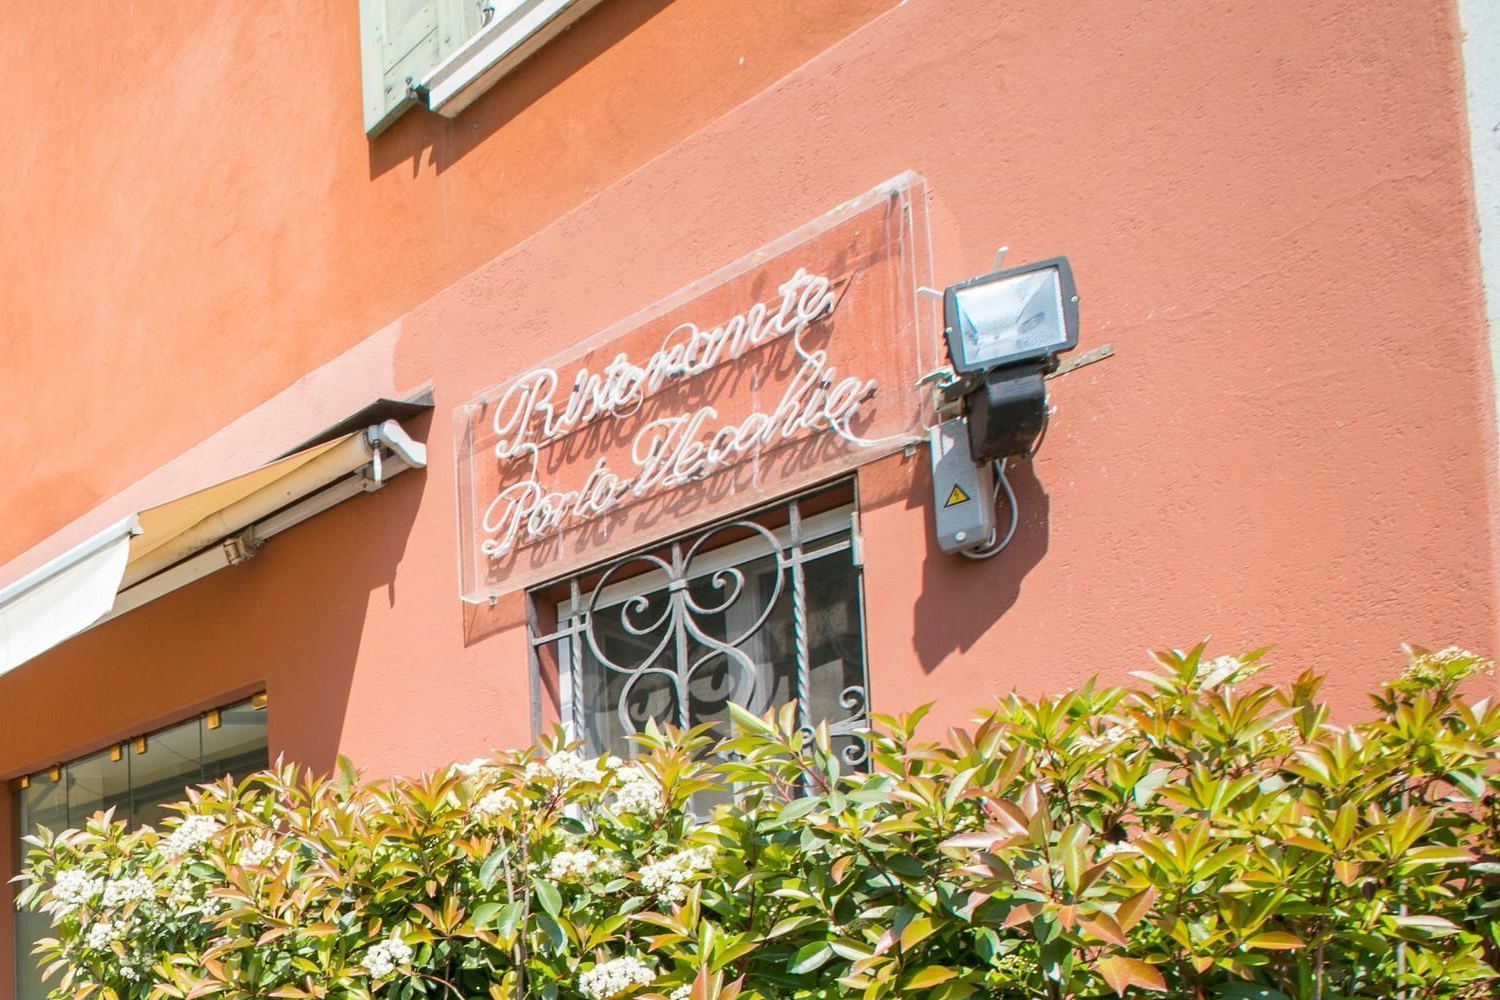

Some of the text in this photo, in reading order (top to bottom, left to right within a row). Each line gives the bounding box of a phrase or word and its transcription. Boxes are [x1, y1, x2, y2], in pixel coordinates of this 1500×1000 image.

[482, 350, 878, 558] Porto Vecchio
[494, 267, 836, 459] Ristorante
